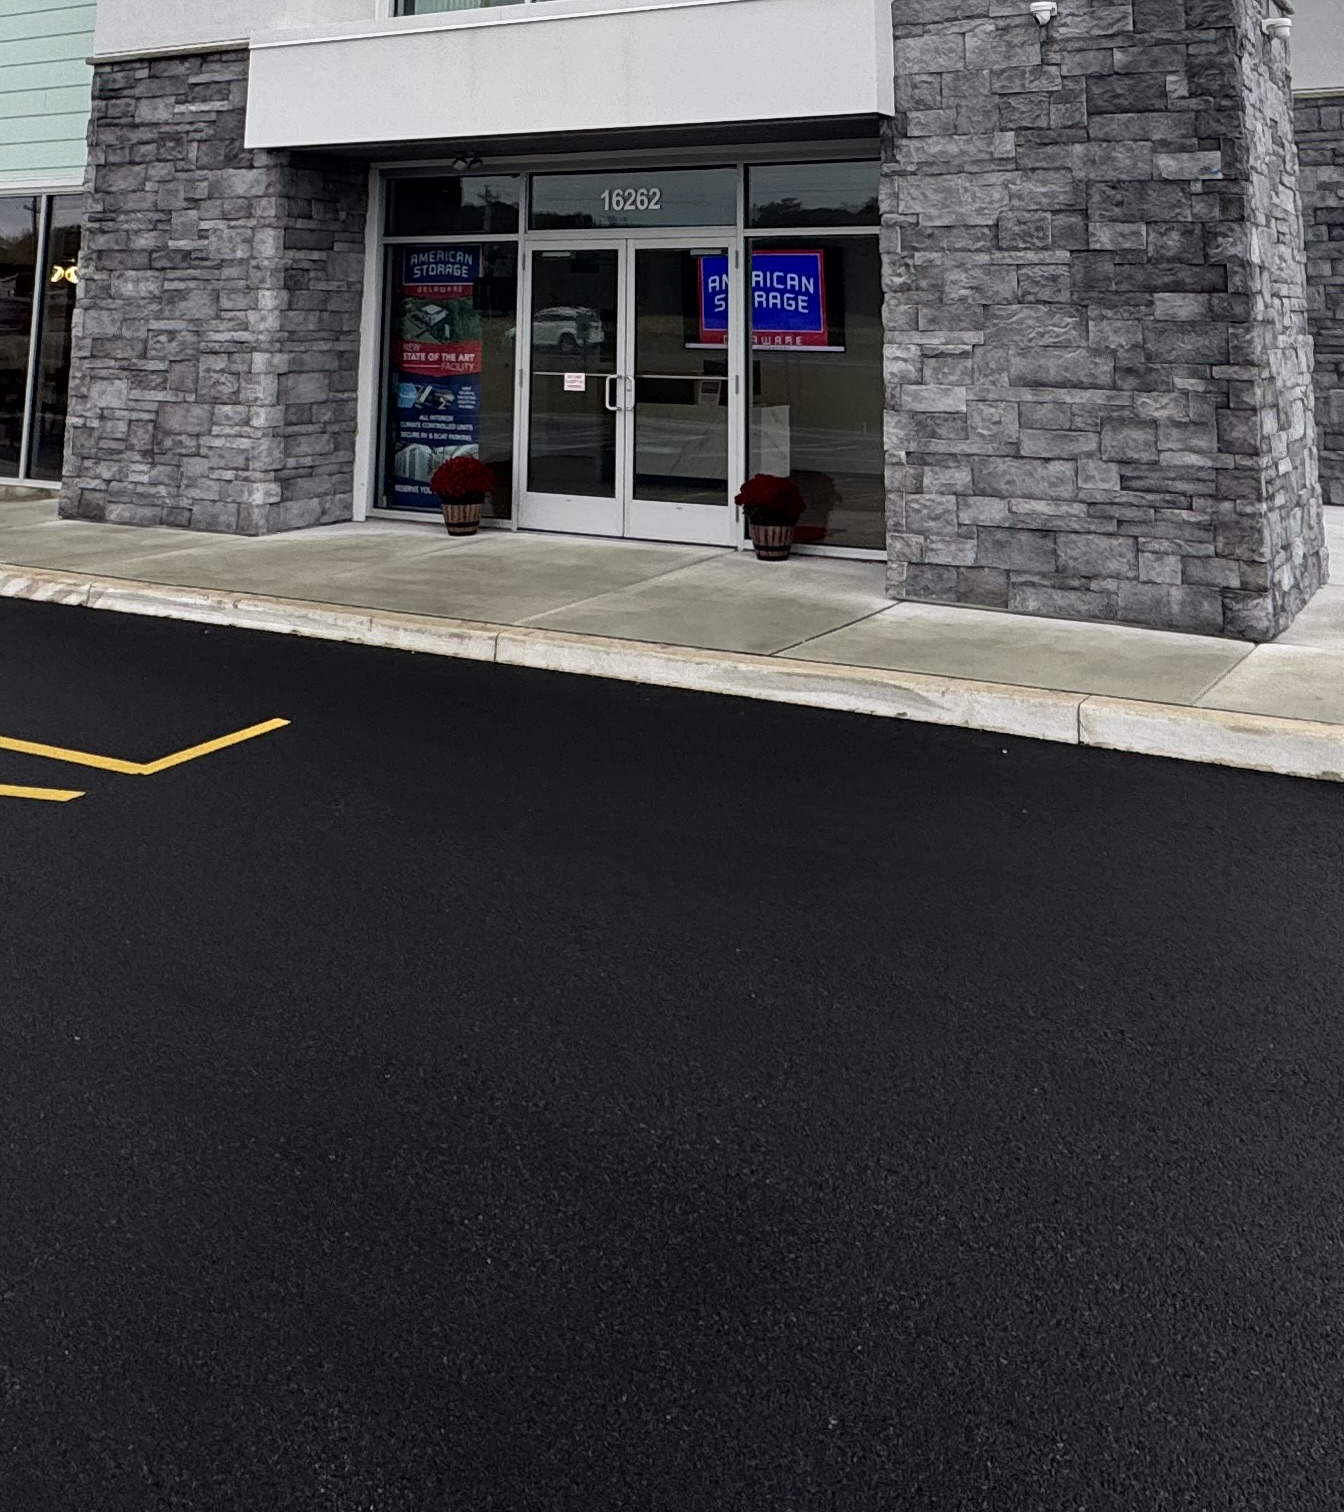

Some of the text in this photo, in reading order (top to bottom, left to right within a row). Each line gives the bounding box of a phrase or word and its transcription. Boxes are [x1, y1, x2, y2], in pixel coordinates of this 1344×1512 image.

[600, 188, 661, 211] 16262
[410, 250, 473, 266] AMERICAN
[413, 263, 469, 278] STORAGE
[714, 291, 809, 313] SRAGE
[403, 352, 475, 362] STATE OF THE ART
[441, 362, 475, 371] FACILITY
